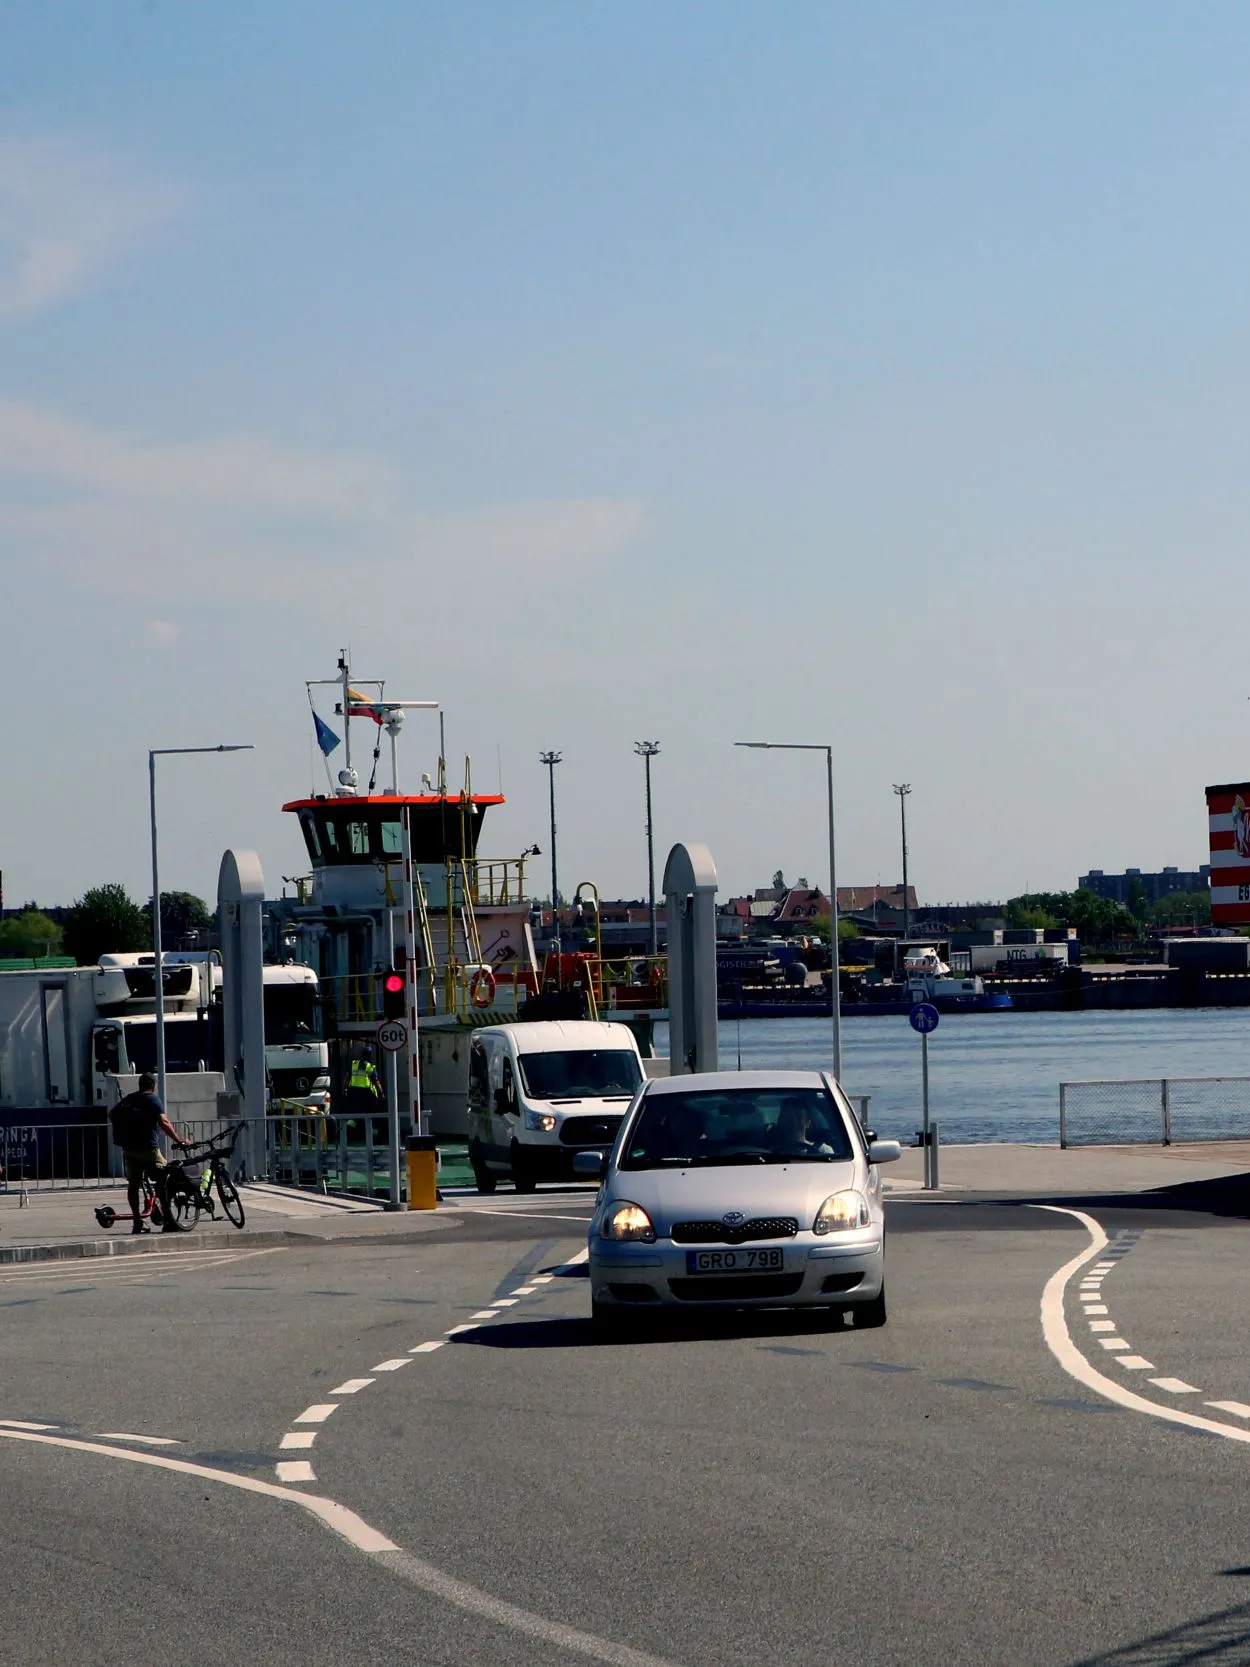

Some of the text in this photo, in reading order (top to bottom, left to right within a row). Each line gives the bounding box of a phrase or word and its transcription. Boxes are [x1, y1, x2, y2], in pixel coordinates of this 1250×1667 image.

[1007, 949, 1027, 961] NTG
[381, 1030, 404, 1042] 60t
[699, 1250, 780, 1269] GRO 798
